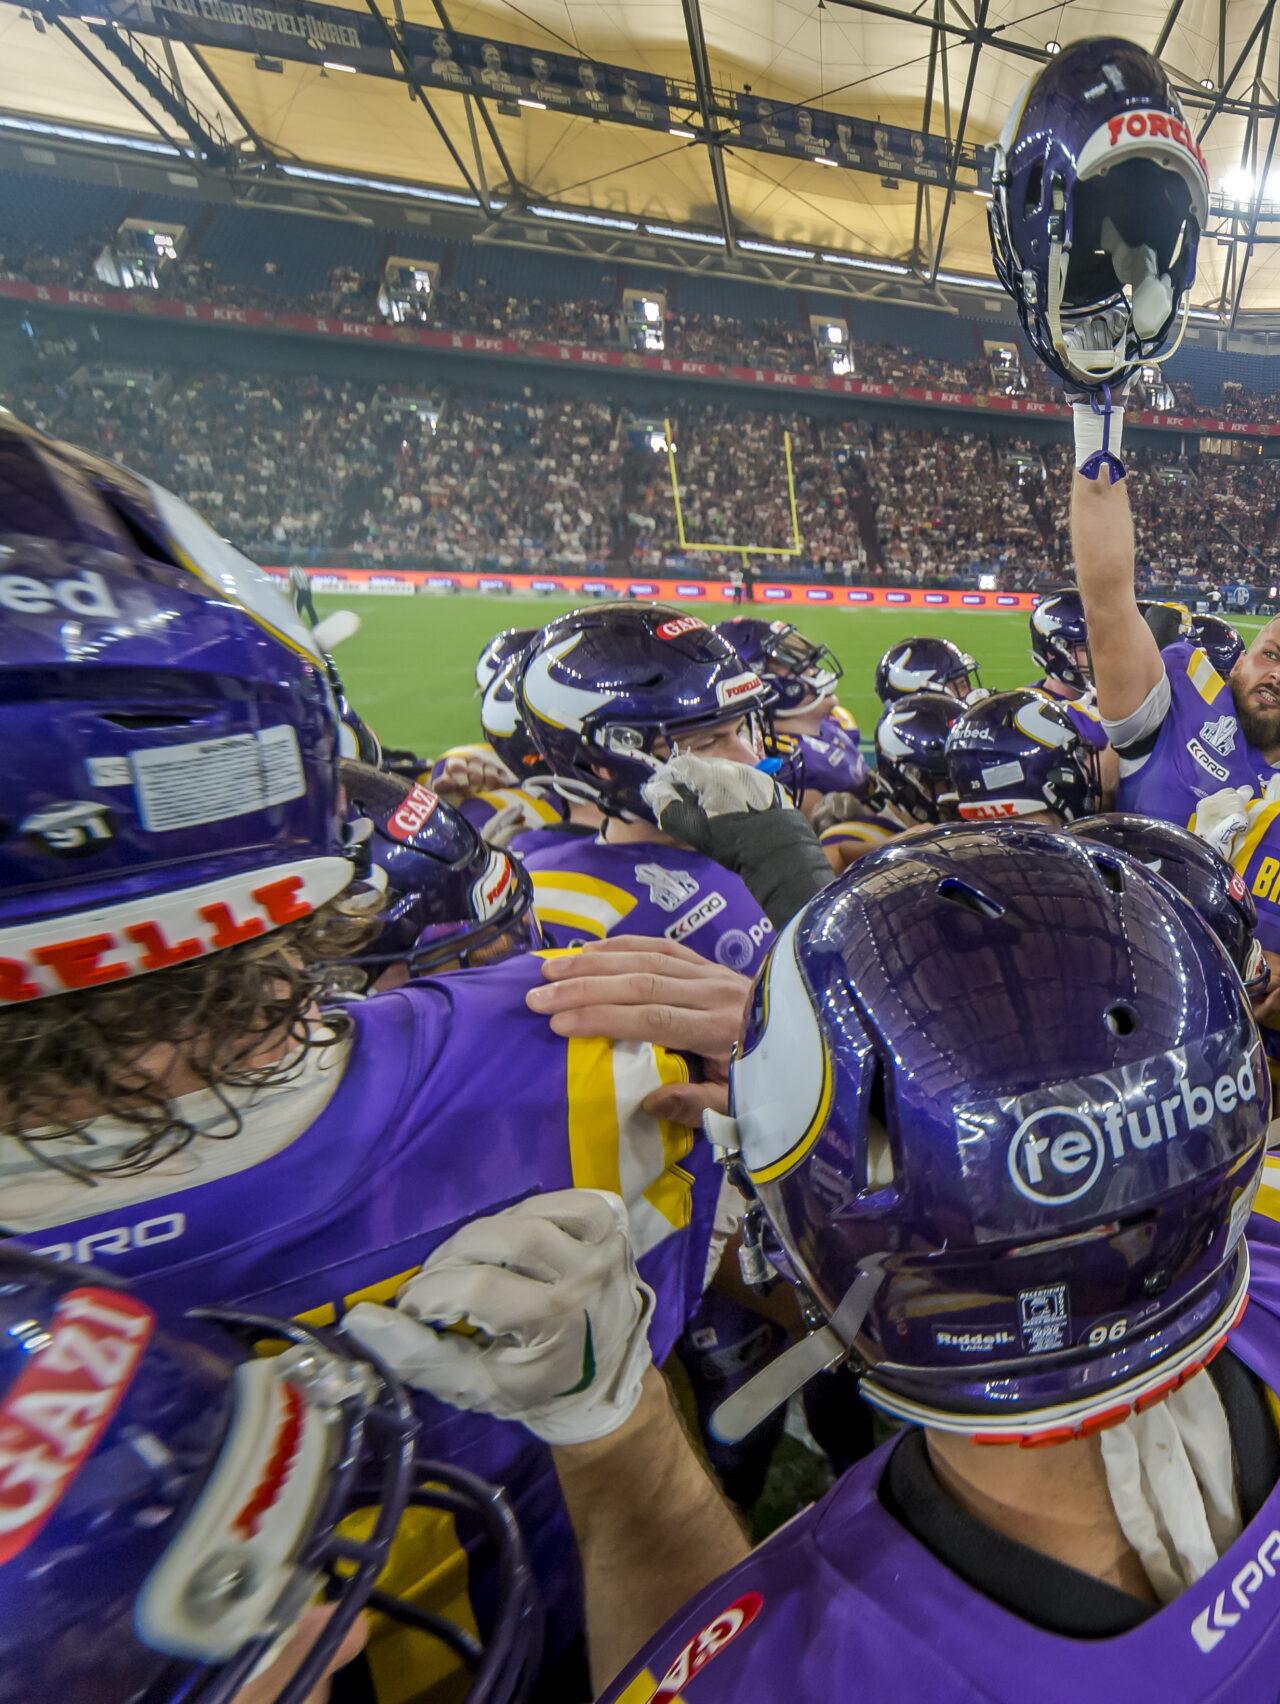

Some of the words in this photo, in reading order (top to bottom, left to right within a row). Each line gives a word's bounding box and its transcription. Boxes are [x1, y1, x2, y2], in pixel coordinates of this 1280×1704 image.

[68, 290, 104, 306] KFC
[213, 308, 246, 322] KFC
[342, 323, 373, 336] KFC
[475, 337, 503, 351] KFC
[581, 350, 606, 363] KFC
[682, 363, 706, 374] KFC
[774, 373, 797, 385] KFC
[861, 383, 882, 394] KFC
[941, 392, 961, 403] KFC
[1026, 402, 1046, 412] KFC
[1166, 417, 1184, 427] KFC
[1230, 423, 1248, 432] KFC
[1008, 1052, 1257, 1205] refurbed
[936, 1331, 1009, 1346] Riddell
[1088, 1319, 1127, 1348] 96
